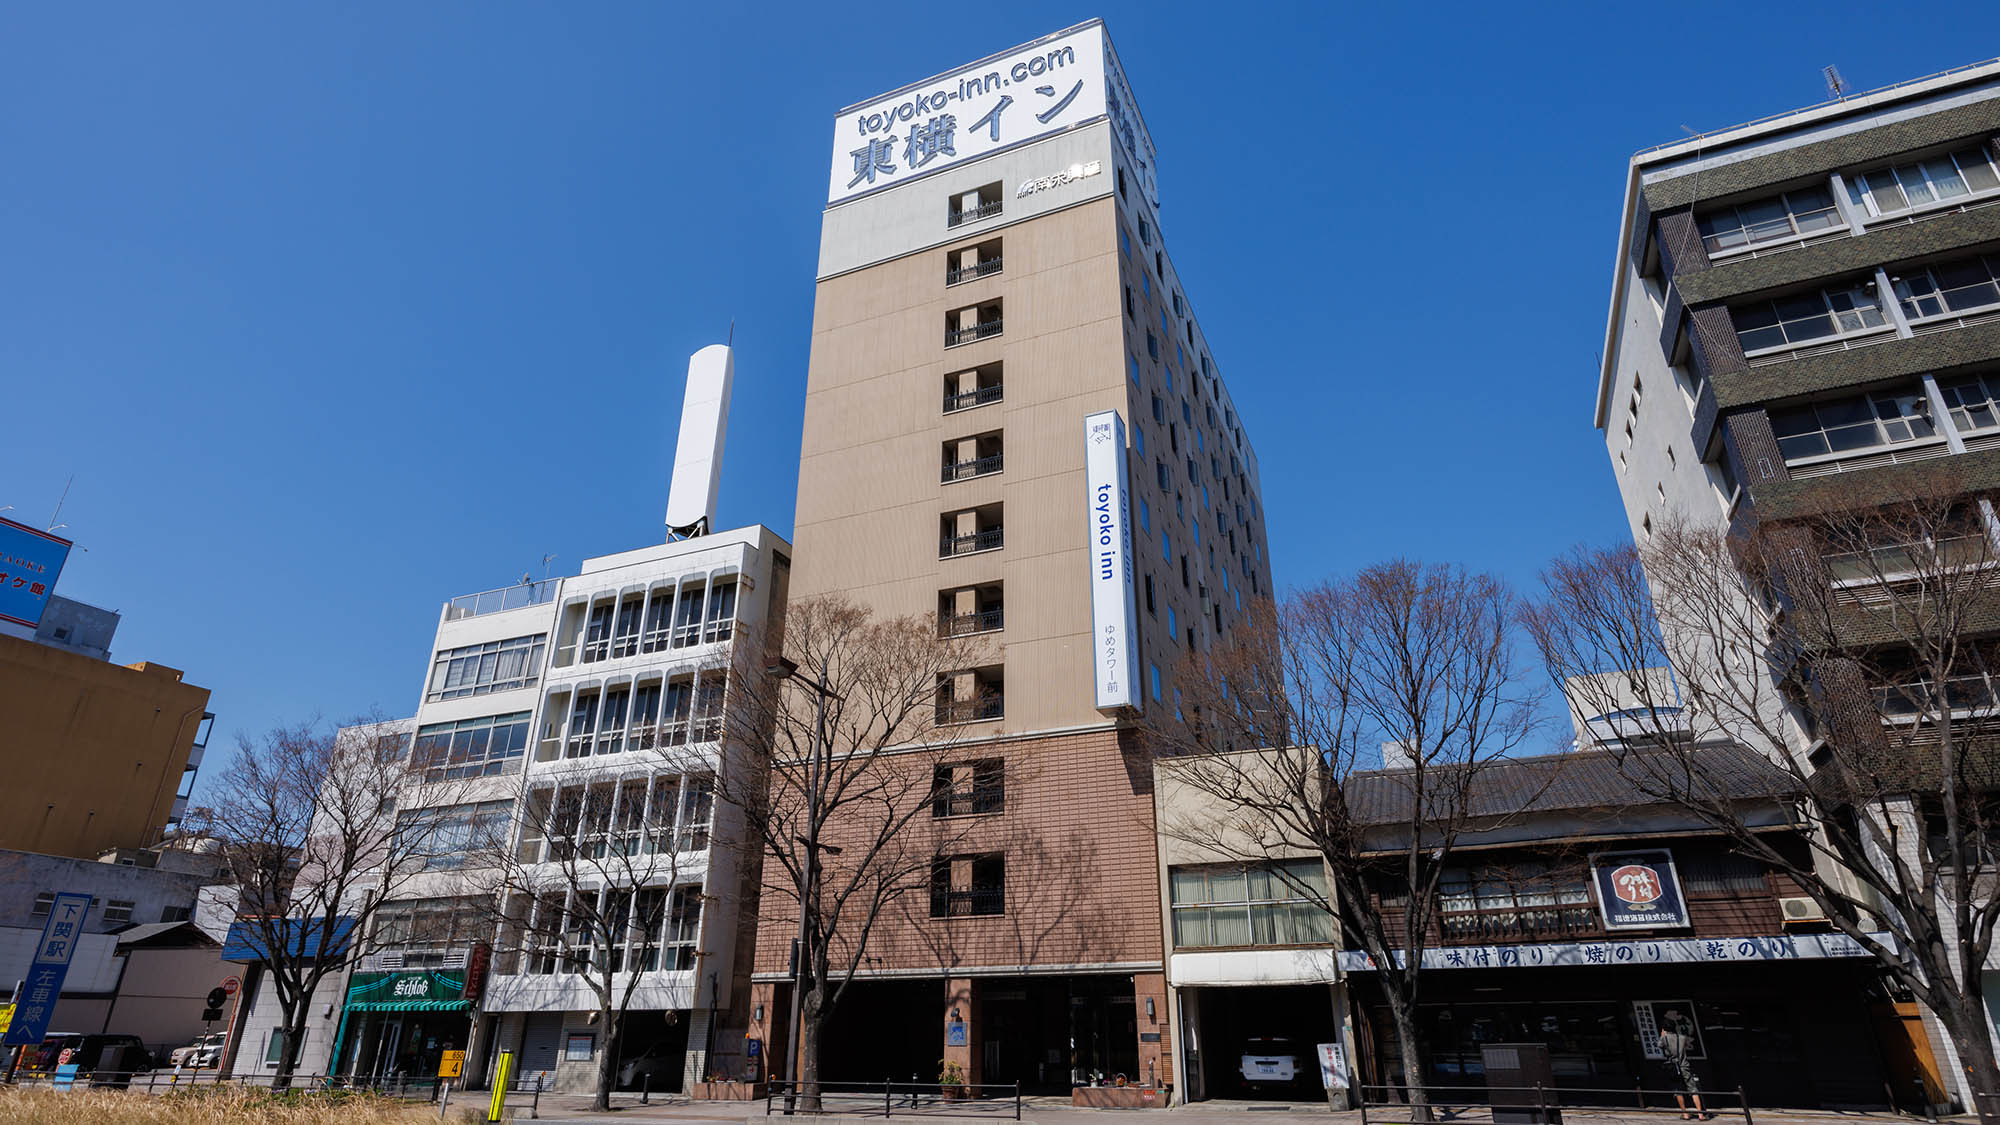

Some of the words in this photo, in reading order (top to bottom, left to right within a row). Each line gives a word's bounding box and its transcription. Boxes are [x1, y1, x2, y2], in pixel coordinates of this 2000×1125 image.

[858, 45, 1075, 136] toyoko-inn.com
[847, 79, 1084, 189] 東横イン
[1096, 484, 1113, 546] toyoko
[1101, 551, 1115, 580] inn
[1104, 625, 1118, 693] ゆめタワー前
[44, 903, 81, 957] 下関駅
[1445, 947, 1544, 967] 味付のり
[1585, 945, 1662, 964] 焼のり
[1706, 941, 1787, 960] 乾のり
[17, 969, 57, 1039] 左車線へ
[452, 1062, 459, 1075] 4
[750, 1041, 758, 1055] P
